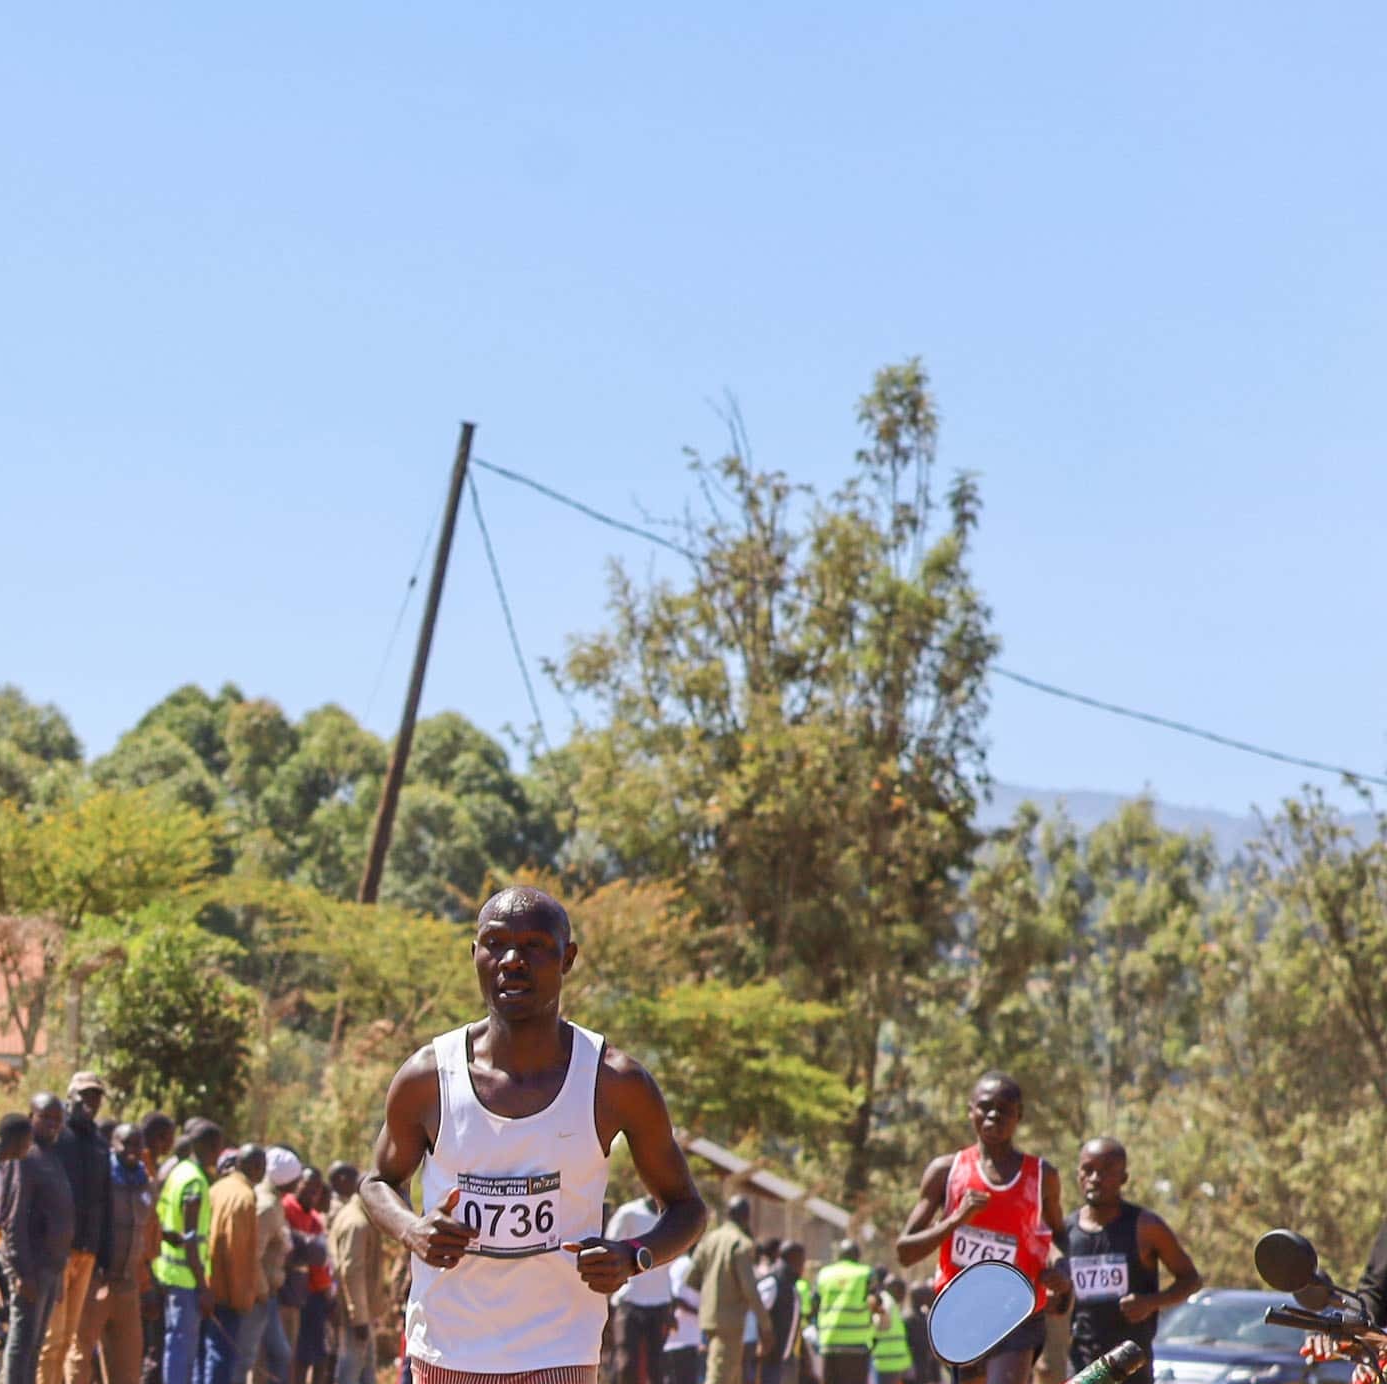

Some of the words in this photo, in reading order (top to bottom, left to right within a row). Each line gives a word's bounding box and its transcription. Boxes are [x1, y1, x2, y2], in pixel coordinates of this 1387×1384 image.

[506, 1184, 528, 1195] RUN
[463, 1199, 555, 1239] 0736
[955, 1235, 1011, 1261] 0767
[1075, 1268, 1124, 1290] 0789
